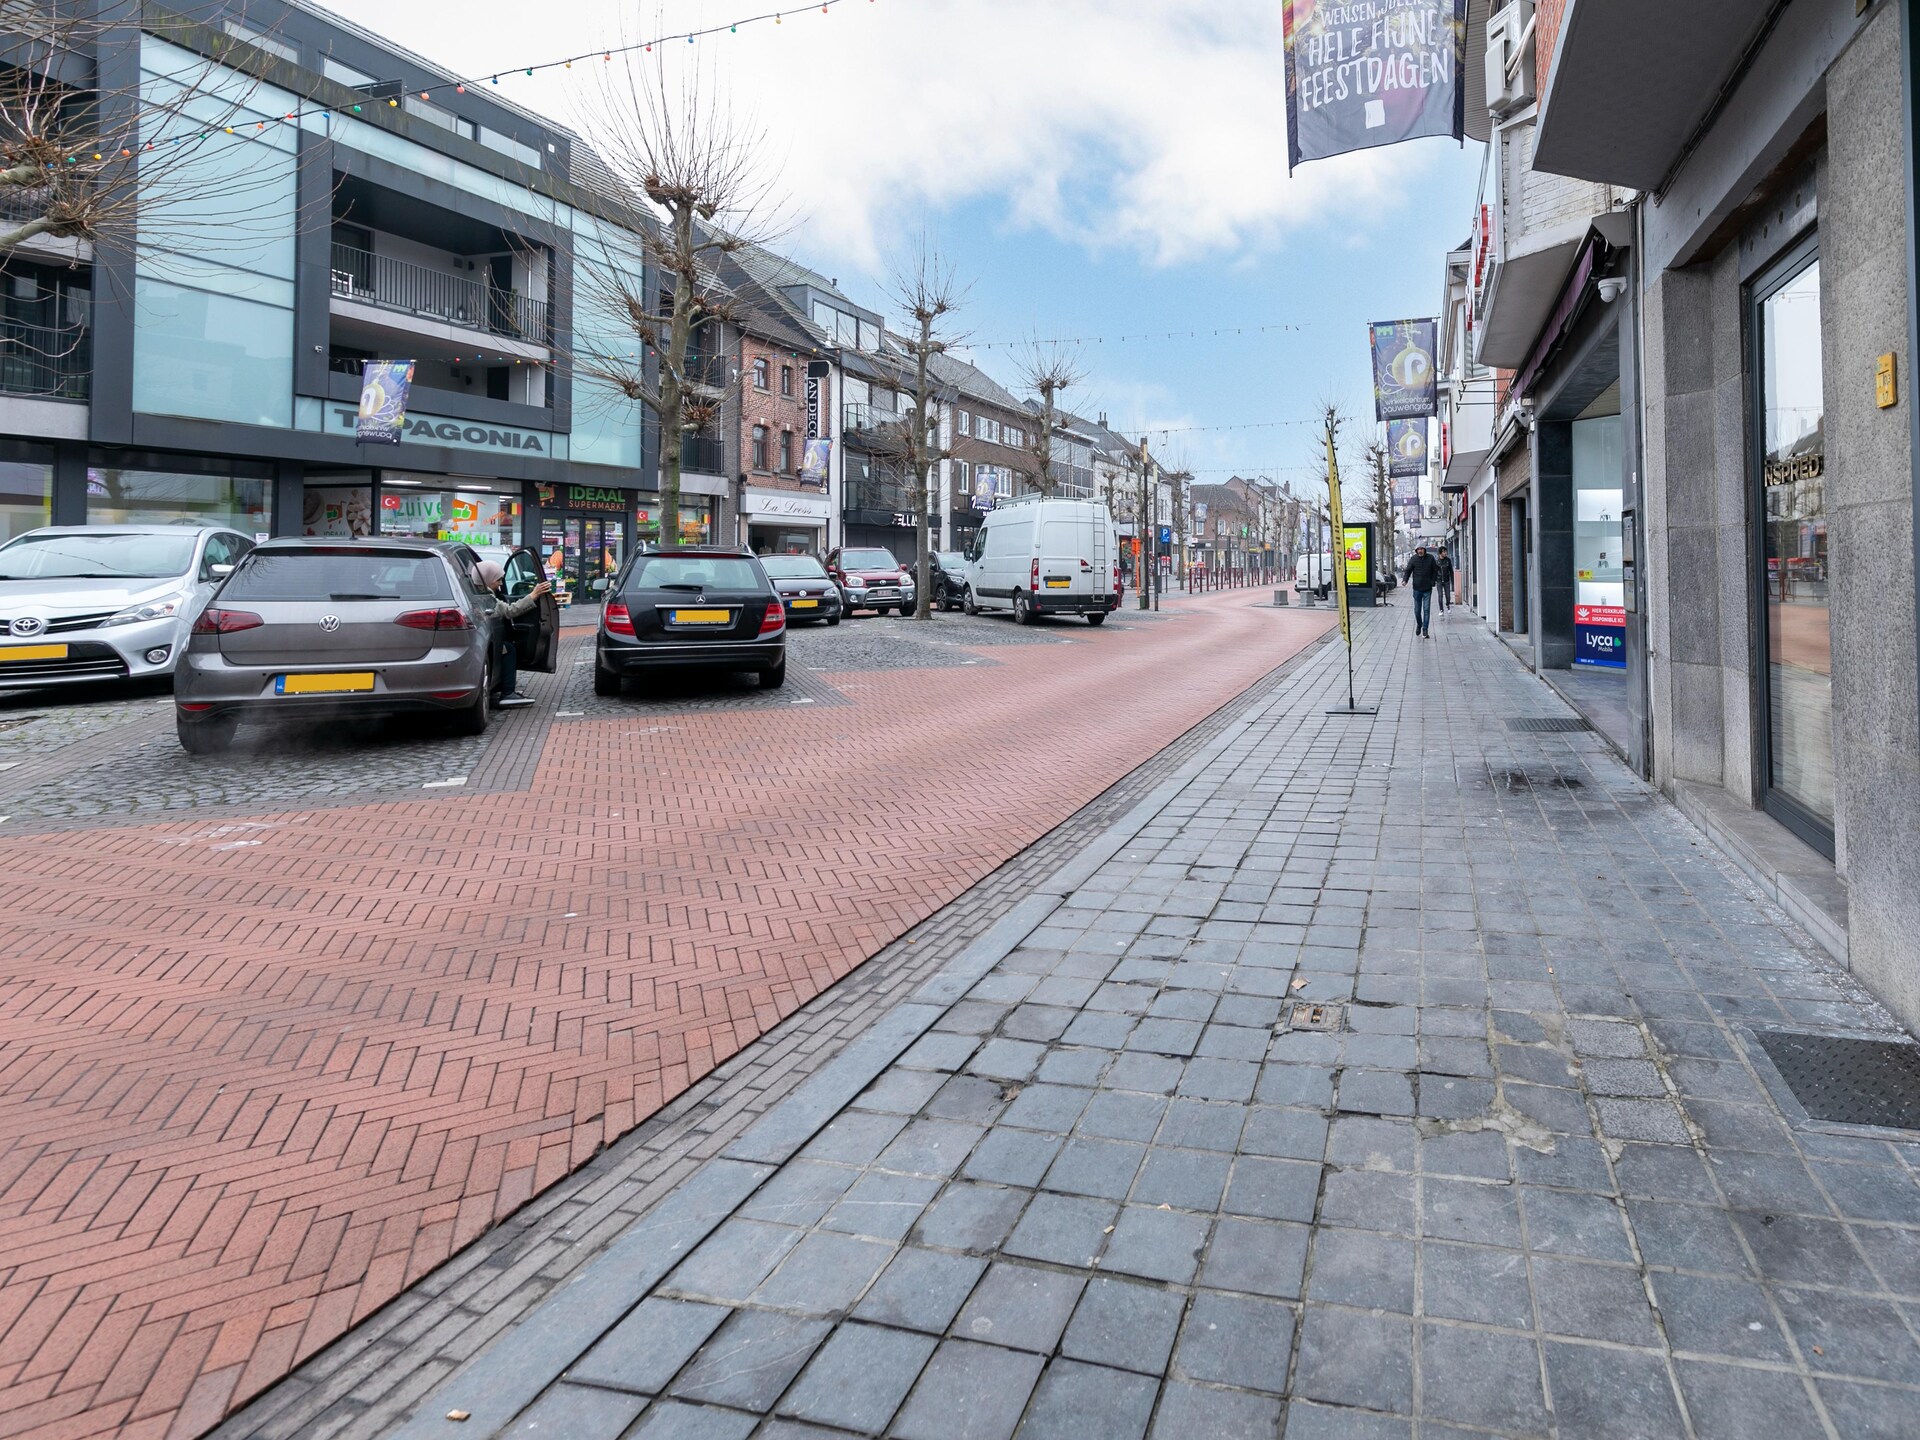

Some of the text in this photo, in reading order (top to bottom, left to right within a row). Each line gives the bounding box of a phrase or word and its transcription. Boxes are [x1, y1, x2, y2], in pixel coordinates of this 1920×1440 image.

[1320, 1, 1376, 26] WENSEN
[1308, 8, 1438, 67] HELE FIJNE
[1301, 48, 1449, 112] FEESTDAGEN
[808, 403, 817, 439] DECO
[568, 486, 626, 502] IDEAAL
[568, 501, 626, 511] SUPERMARKT
[1586, 632, 1613, 647] Lyca
